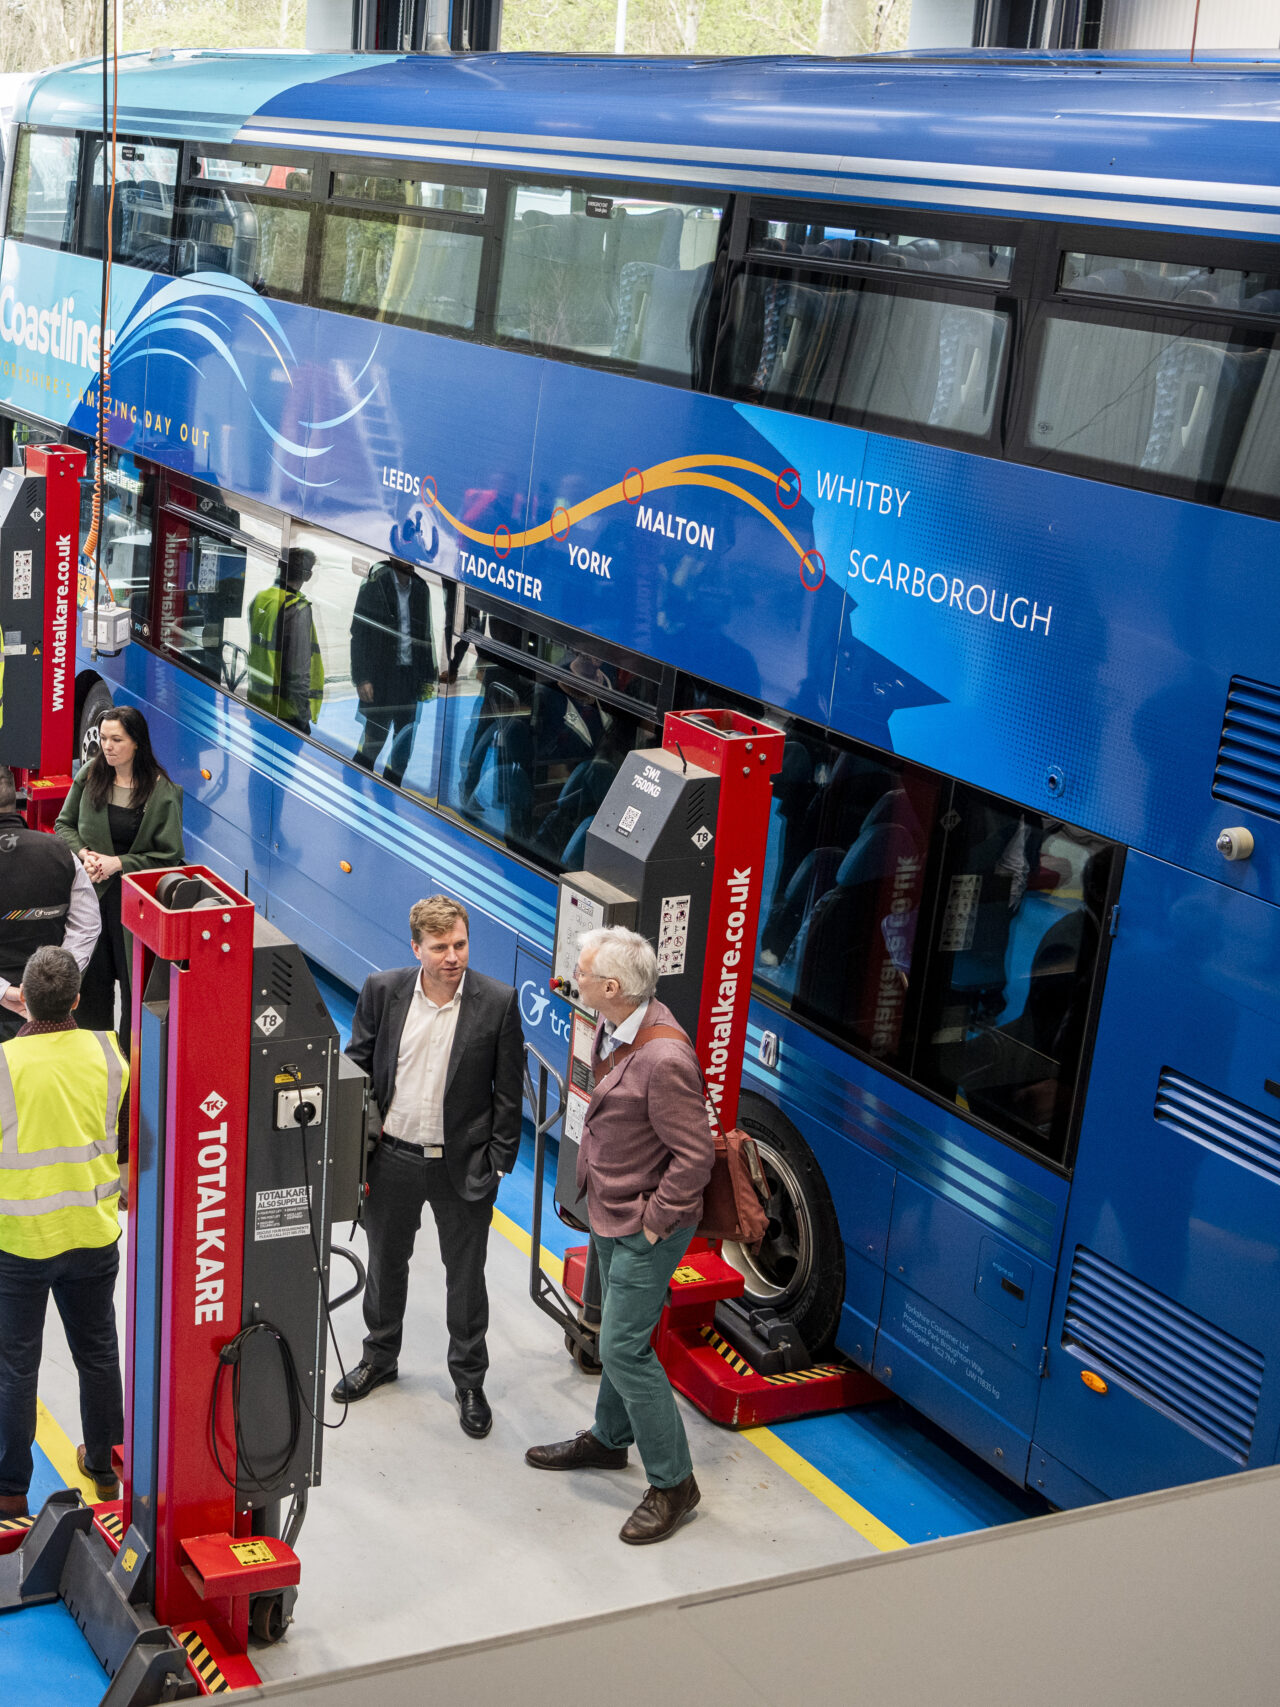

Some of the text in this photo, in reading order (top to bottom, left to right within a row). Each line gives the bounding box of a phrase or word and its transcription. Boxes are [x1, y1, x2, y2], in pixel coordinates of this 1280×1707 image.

[78, 387, 138, 423] AMZING
[146, 410, 172, 435] DAY
[180, 423, 210, 449] OUT
[382, 465, 420, 496] LEEDS
[817, 469, 911, 518] WHITBY
[636, 505, 716, 550] MALTON
[459, 550, 543, 601] TADCASTER
[568, 543, 613, 579] YORK
[847, 549, 1053, 636] SCARBOROUGH
[52, 533, 72, 713] www.totalkare.co.uk
[631, 774, 662, 798] 7500KG
[642, 765, 661, 783] SWL
[696, 832, 709, 843] T8
[261, 1014, 278, 1027] T8
[705, 866, 752, 1137] ww.totalkare.co.uk
[194, 1121, 228, 1326] TOTALKARE
[257, 1200, 276, 1208] ALSO
[903, 1300, 970, 1353] Yorkshire Coastliner Ltd
[903, 1311, 985, 1375] Prospect Park Broughton Way
[902, 1322, 931, 1347] Harrogate
[991, 1384, 1001, 1400] kg
